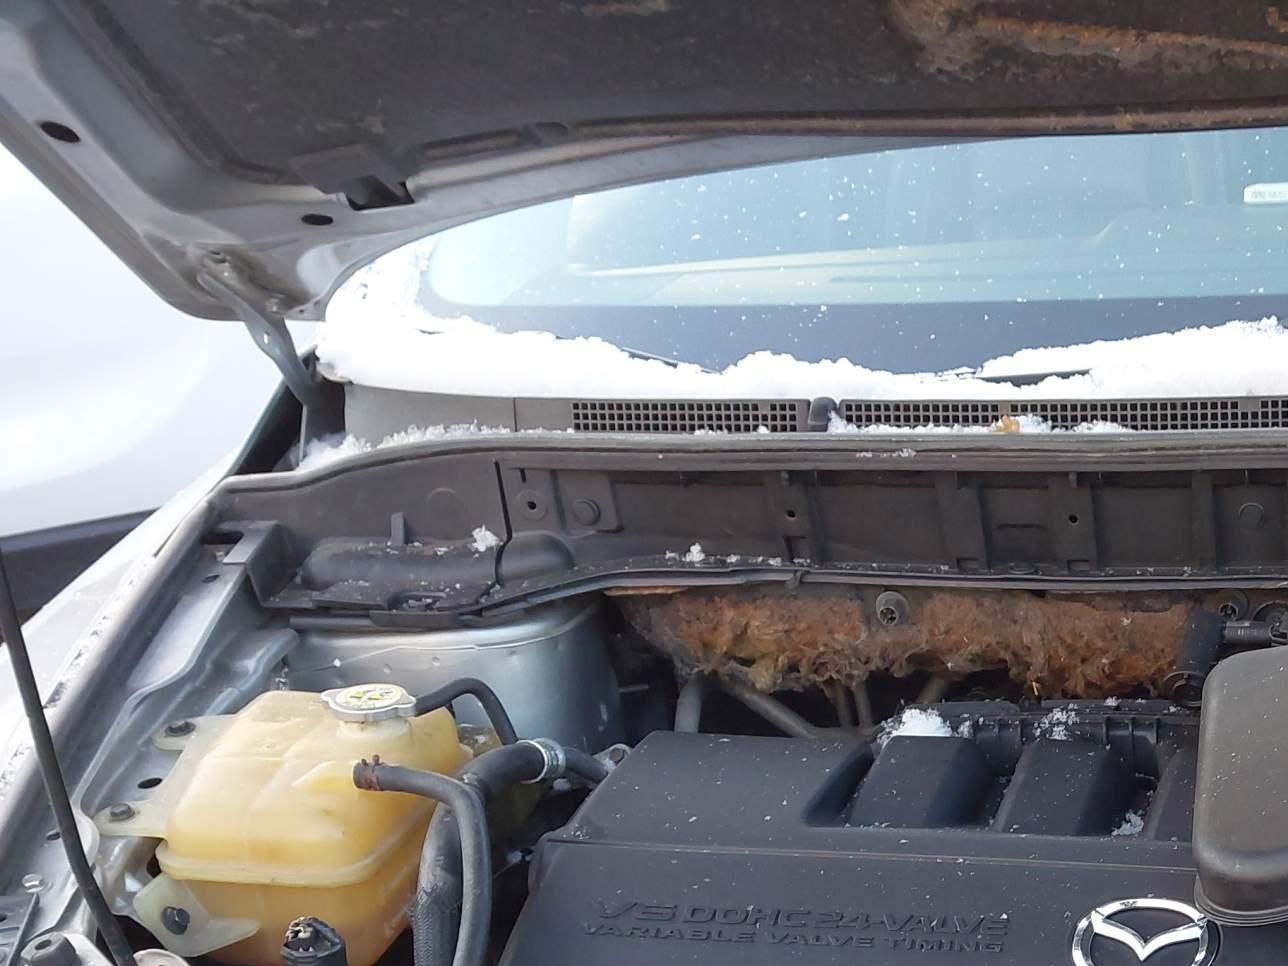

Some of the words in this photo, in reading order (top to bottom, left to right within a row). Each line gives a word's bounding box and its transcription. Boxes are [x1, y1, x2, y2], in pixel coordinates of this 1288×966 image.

[682, 905, 811, 928] DOHC
[813, 911, 1009, 936] 24-VALVE
[582, 923, 756, 944] VARIABLE
[766, 931, 875, 949] VALVE
[884, 935, 1004, 953] TIMING
